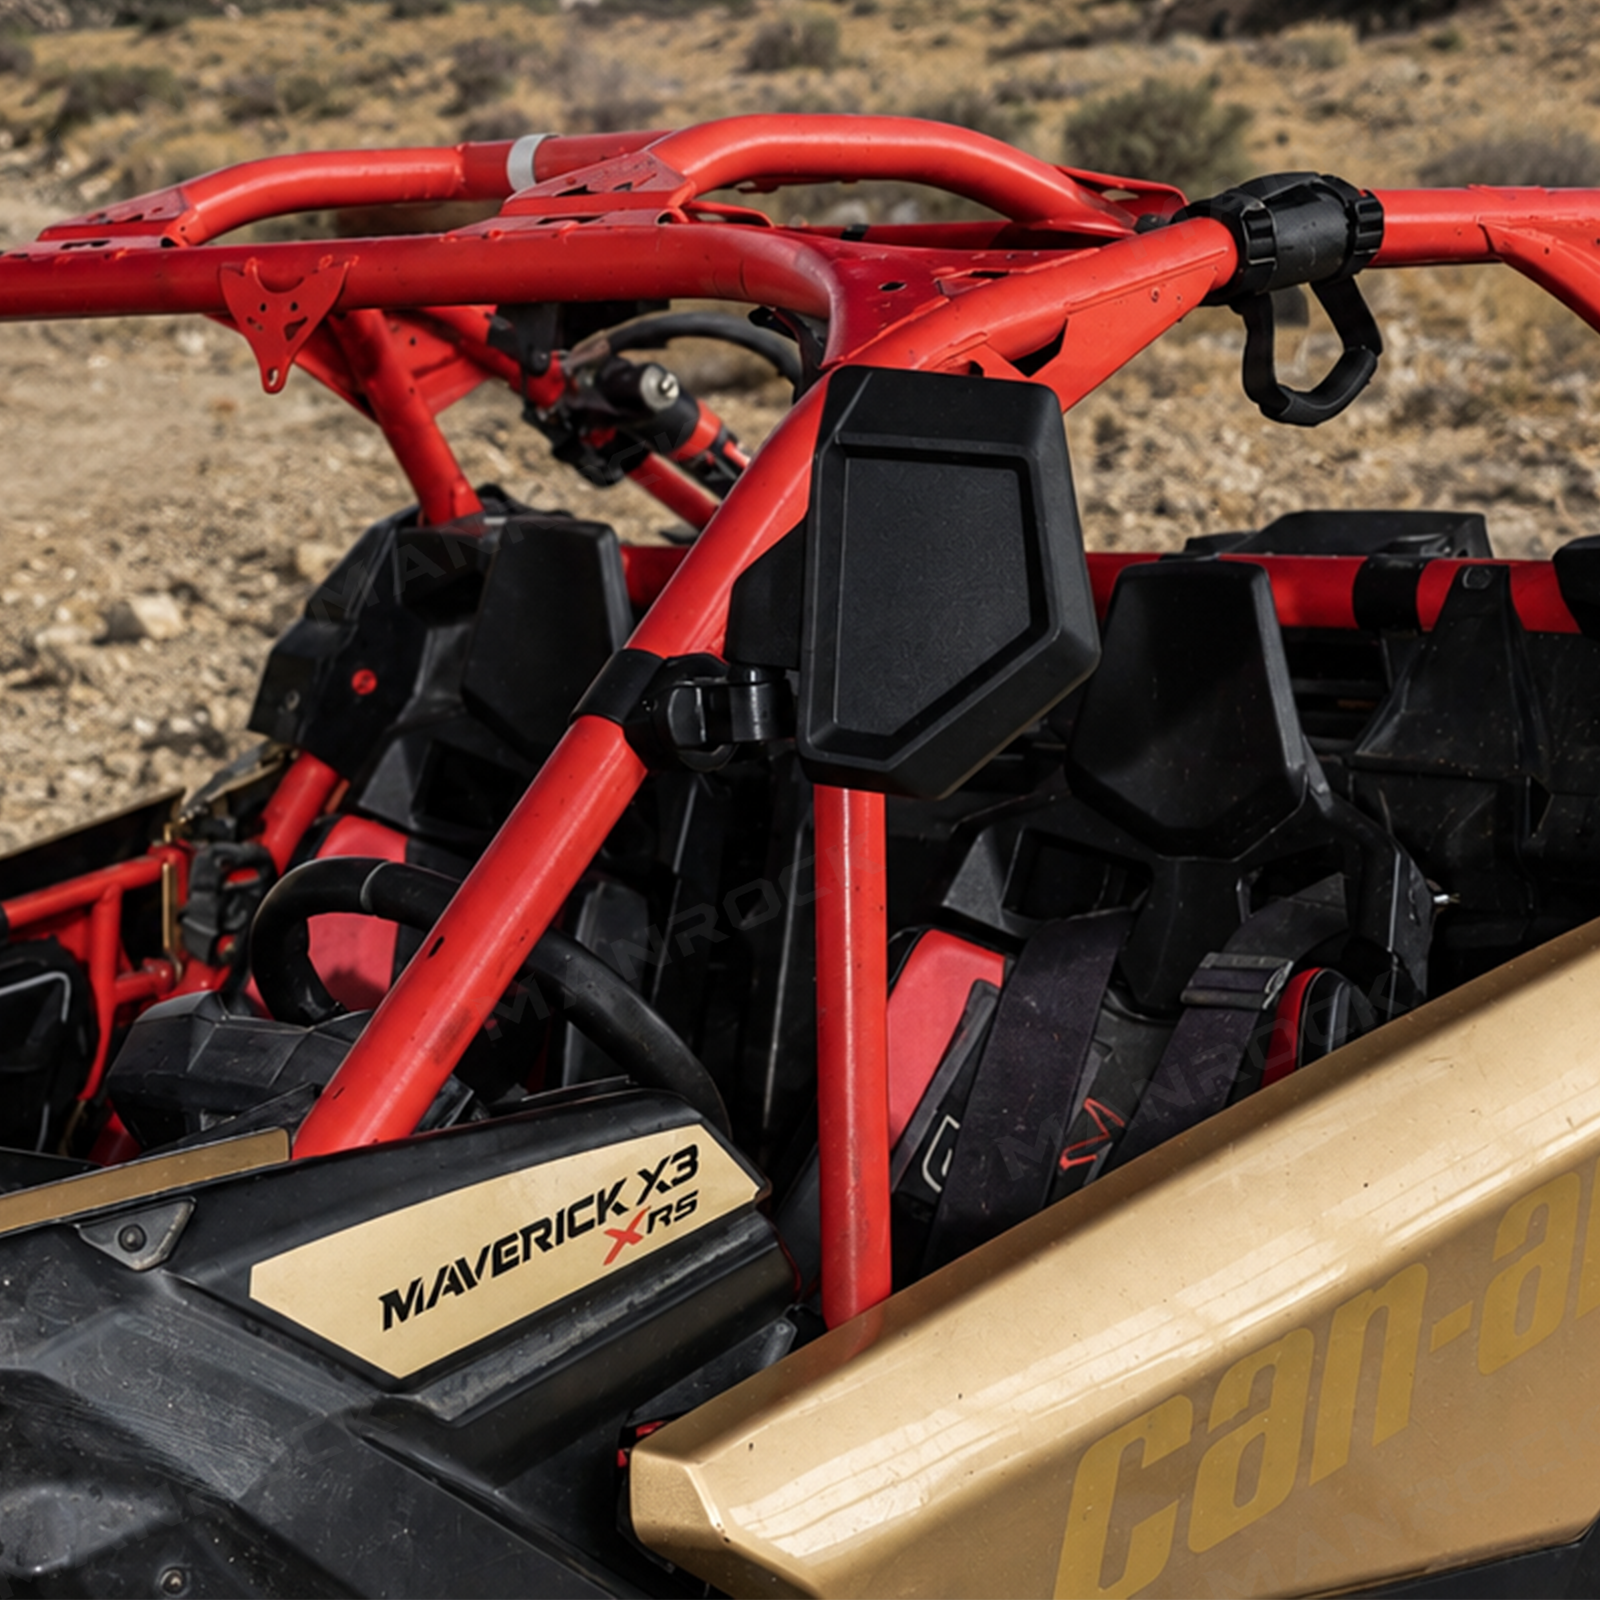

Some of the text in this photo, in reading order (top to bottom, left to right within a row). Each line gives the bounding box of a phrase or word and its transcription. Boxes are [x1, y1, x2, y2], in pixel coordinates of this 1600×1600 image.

[378, 1143, 699, 1332] MAVERICK X3
[1053, 1152, 1600, 1600] can-a
